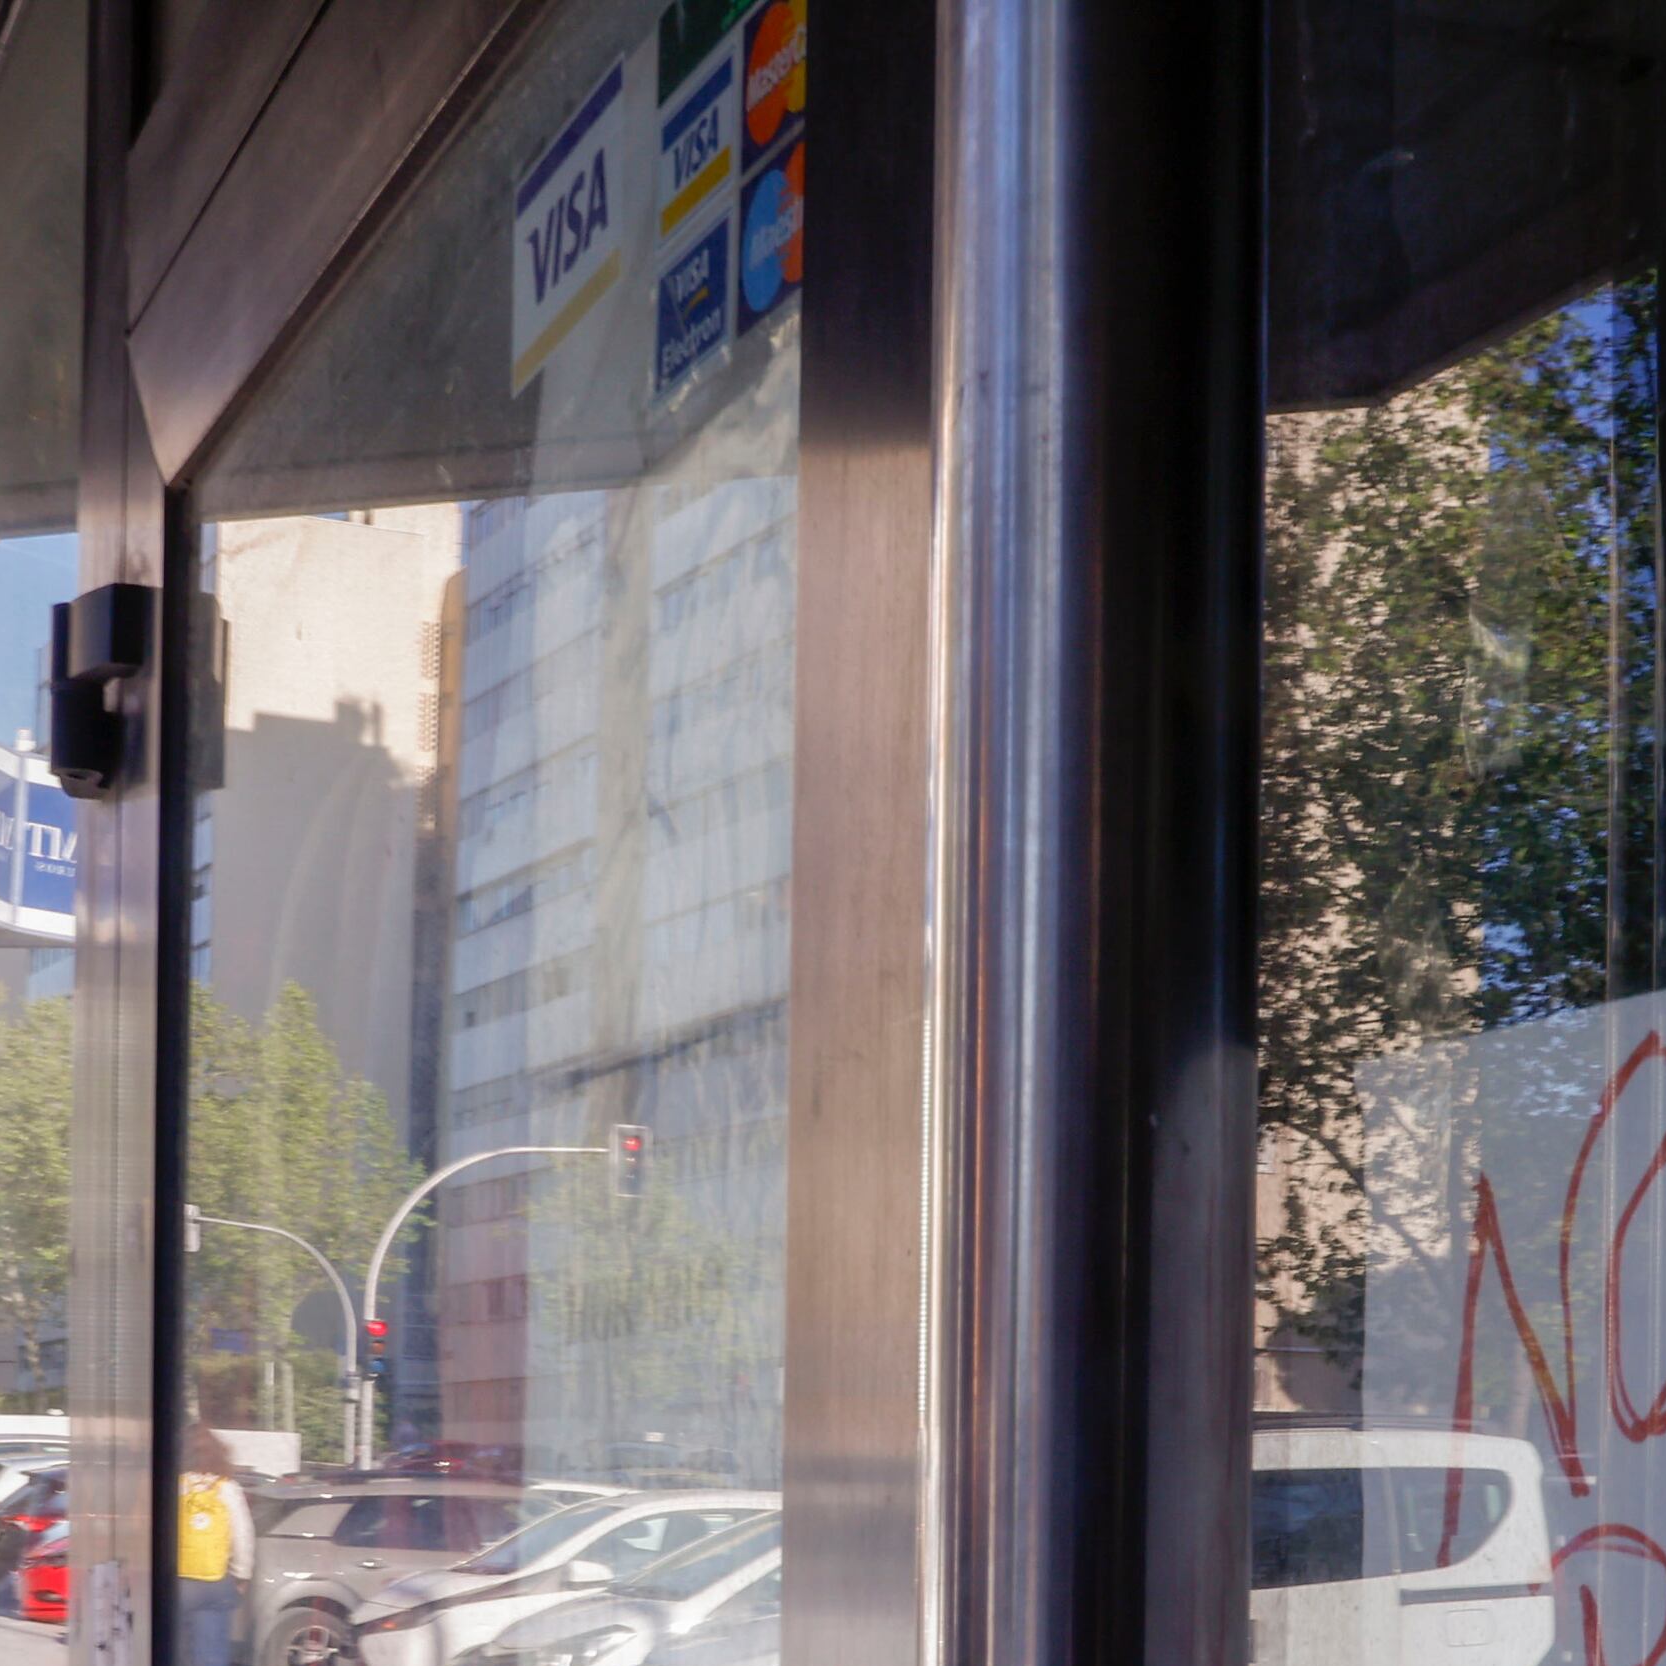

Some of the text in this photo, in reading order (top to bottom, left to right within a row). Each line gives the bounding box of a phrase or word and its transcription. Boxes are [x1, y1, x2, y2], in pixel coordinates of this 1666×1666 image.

[671, 105, 719, 190] VISA
[527, 148, 608, 304] VISA
[675, 249, 710, 300] VISA
